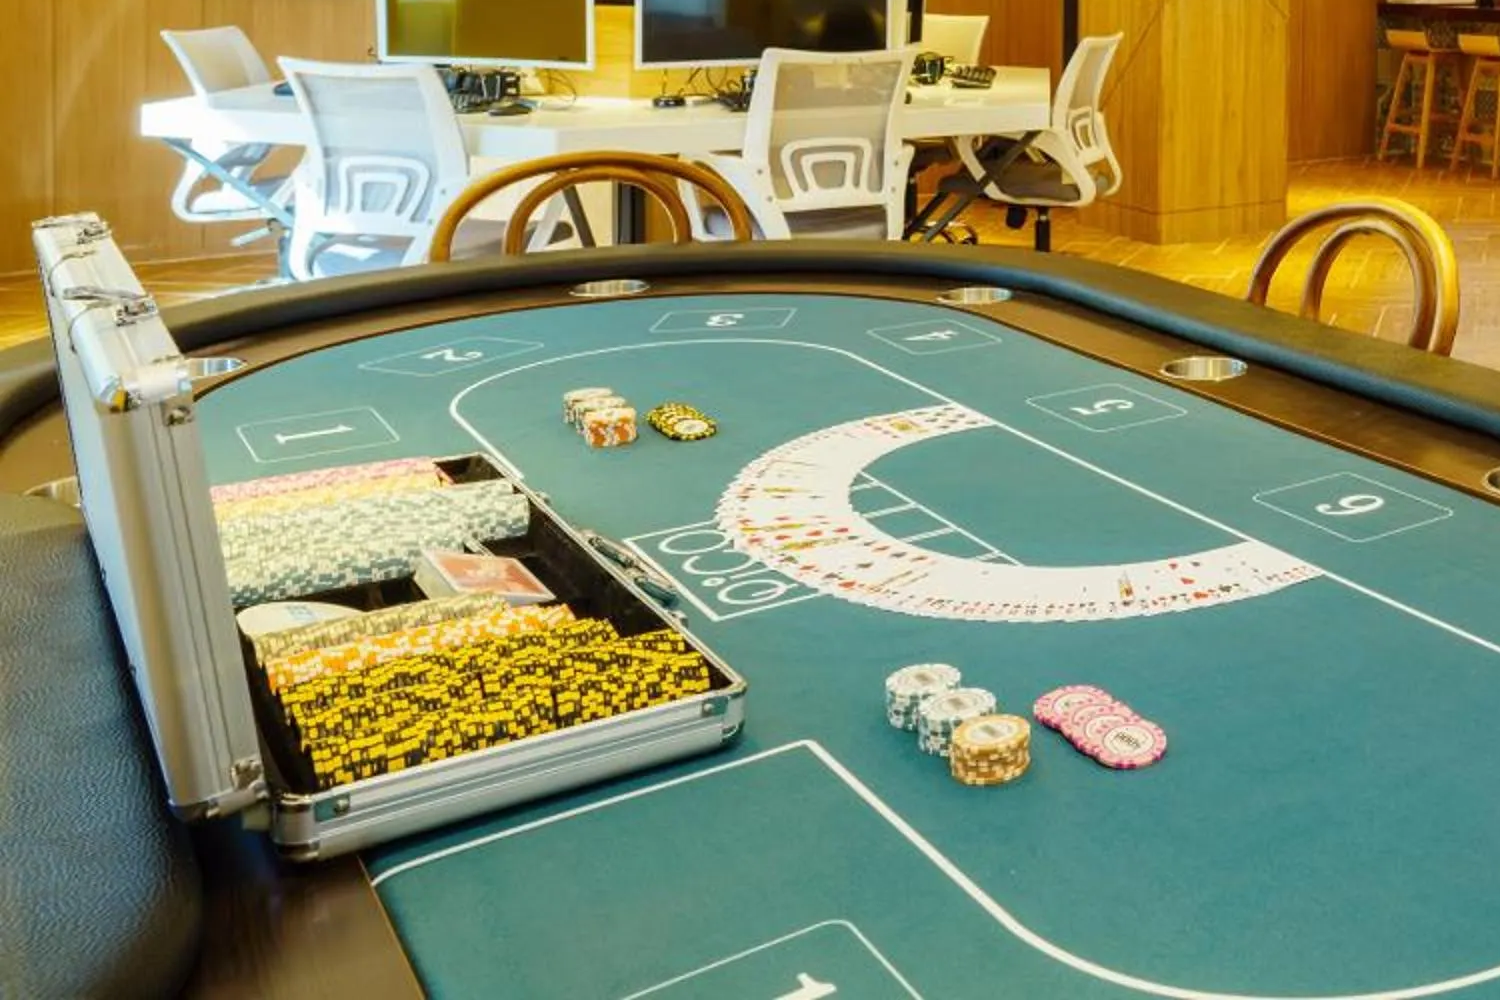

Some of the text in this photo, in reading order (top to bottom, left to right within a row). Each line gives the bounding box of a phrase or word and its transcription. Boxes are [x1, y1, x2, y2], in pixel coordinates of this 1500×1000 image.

[705, 312, 744, 327] 3
[901, 329, 959, 341] 4
[419, 348, 484, 362] 2
[1070, 399, 1135, 415] 5
[272, 422, 356, 445] 1
[1315, 493, 1385, 516] 6
